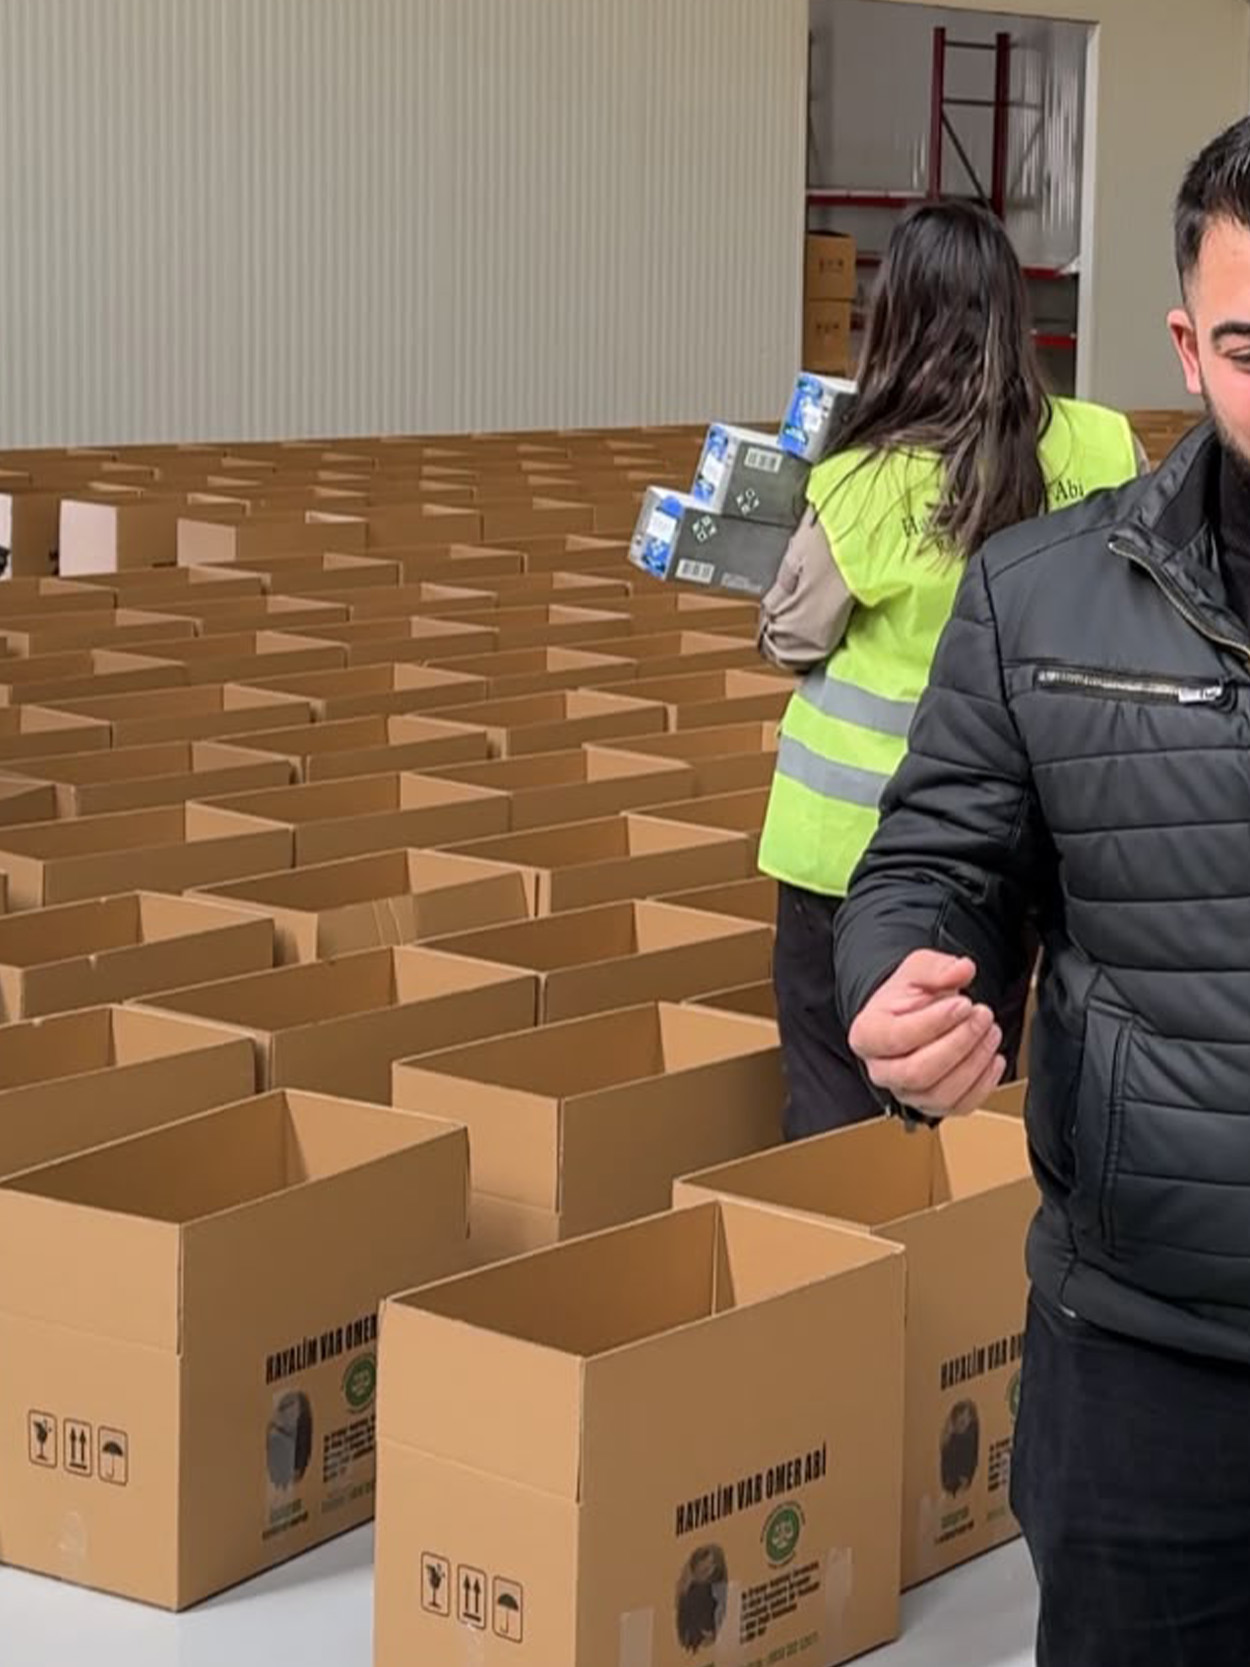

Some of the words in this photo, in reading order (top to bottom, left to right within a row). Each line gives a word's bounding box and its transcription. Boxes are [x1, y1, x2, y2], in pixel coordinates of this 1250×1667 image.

[320, 1326, 343, 1363] VAR
[676, 1483, 733, 1538] HAYALİM
[737, 1473, 763, 1511] VAR
